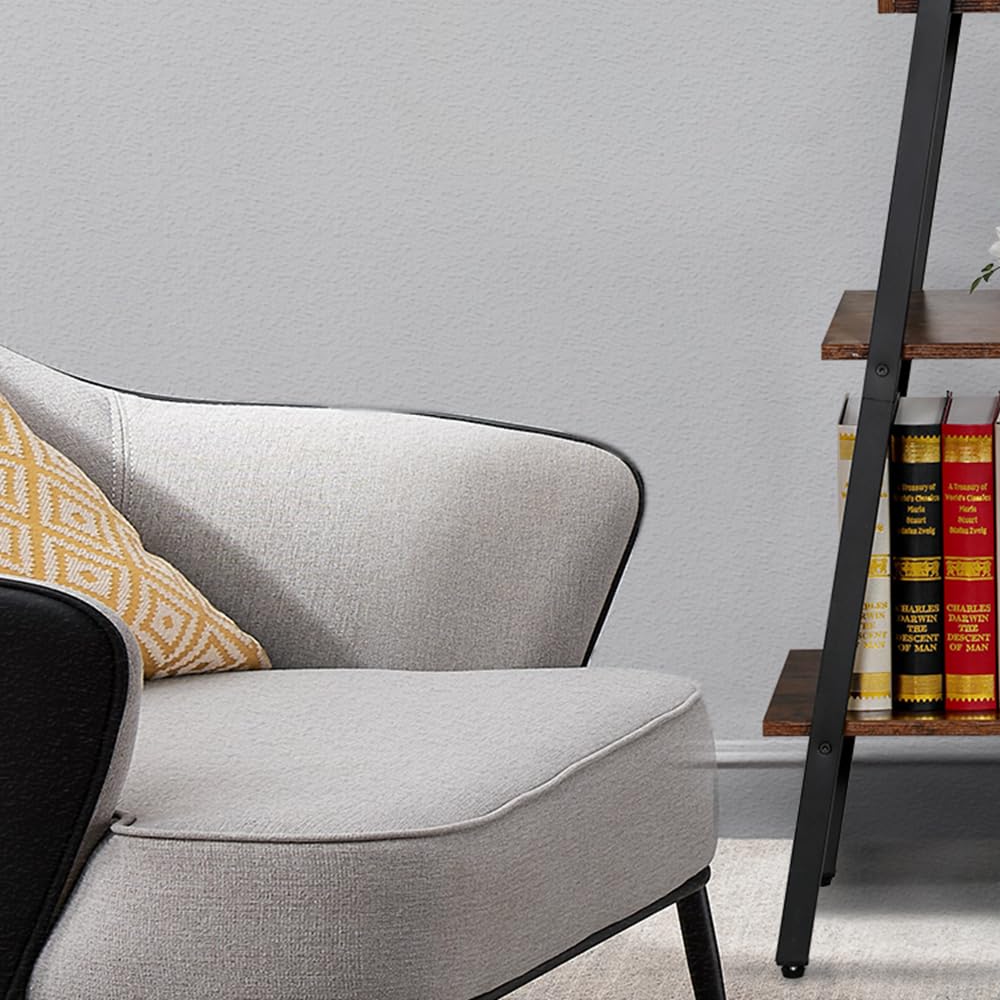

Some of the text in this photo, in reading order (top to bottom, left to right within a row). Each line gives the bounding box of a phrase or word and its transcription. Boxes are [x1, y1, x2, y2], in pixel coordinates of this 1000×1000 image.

[896, 604, 940, 613] CHARLES
[946, 603, 992, 613] CHARLES
[897, 614, 938, 623] DARWIN
[948, 613, 990, 623] DARWIN
[906, 624, 928, 633] THE
[958, 624, 979, 633] THE
[896, 633, 940, 643] DESCENT
[947, 633, 992, 643] DESCENT
[898, 643, 938, 652] OF MAN
[949, 643, 989, 652] OF MAN
